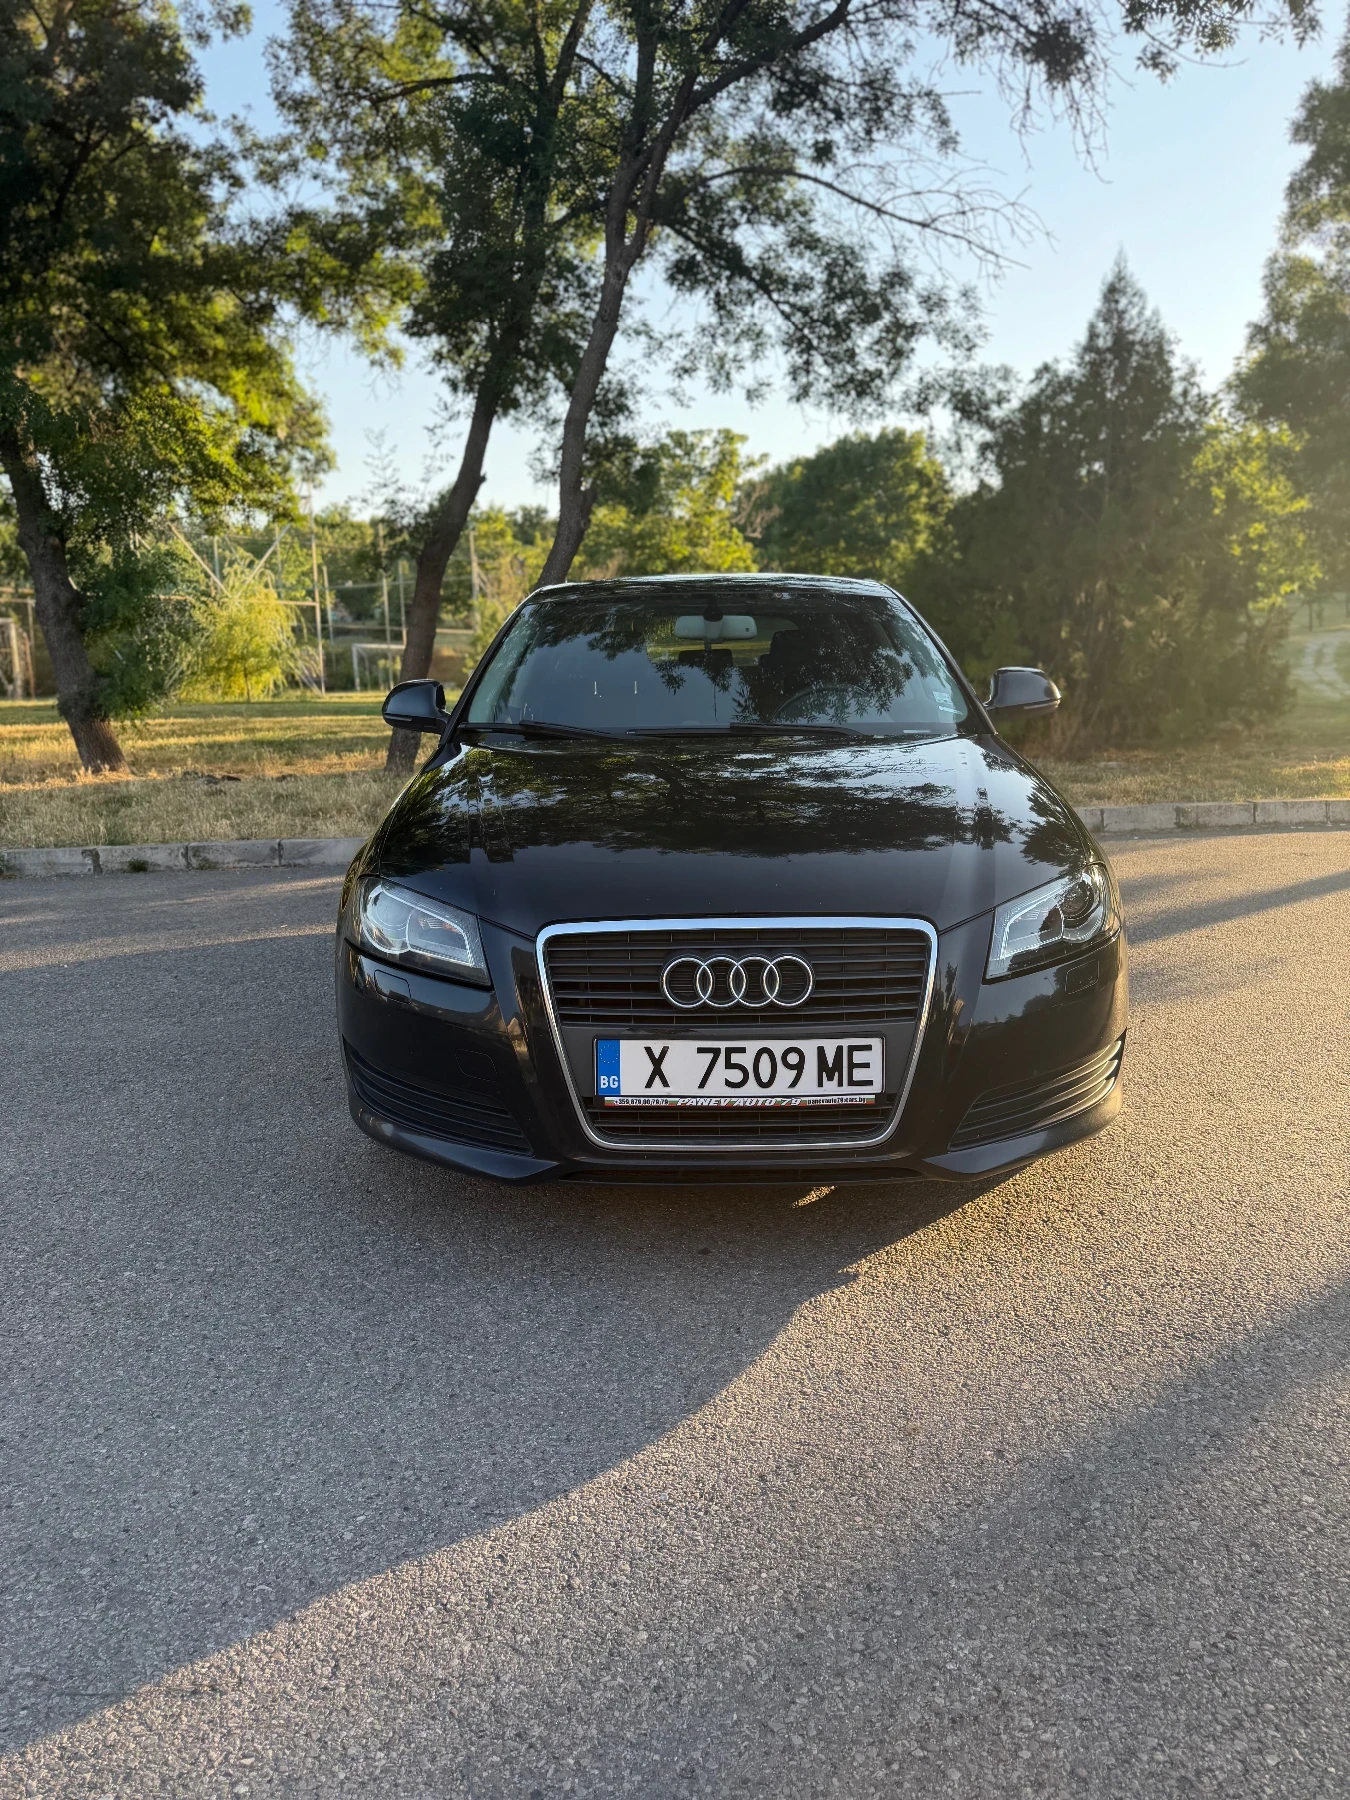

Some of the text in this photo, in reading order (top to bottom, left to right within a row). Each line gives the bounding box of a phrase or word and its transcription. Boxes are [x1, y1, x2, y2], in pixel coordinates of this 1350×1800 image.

[643, 1044, 873, 1088] X 7509 ME
[600, 1076, 618, 1089] BG
[676, 1097, 802, 1106] PANEV AUTO 79
